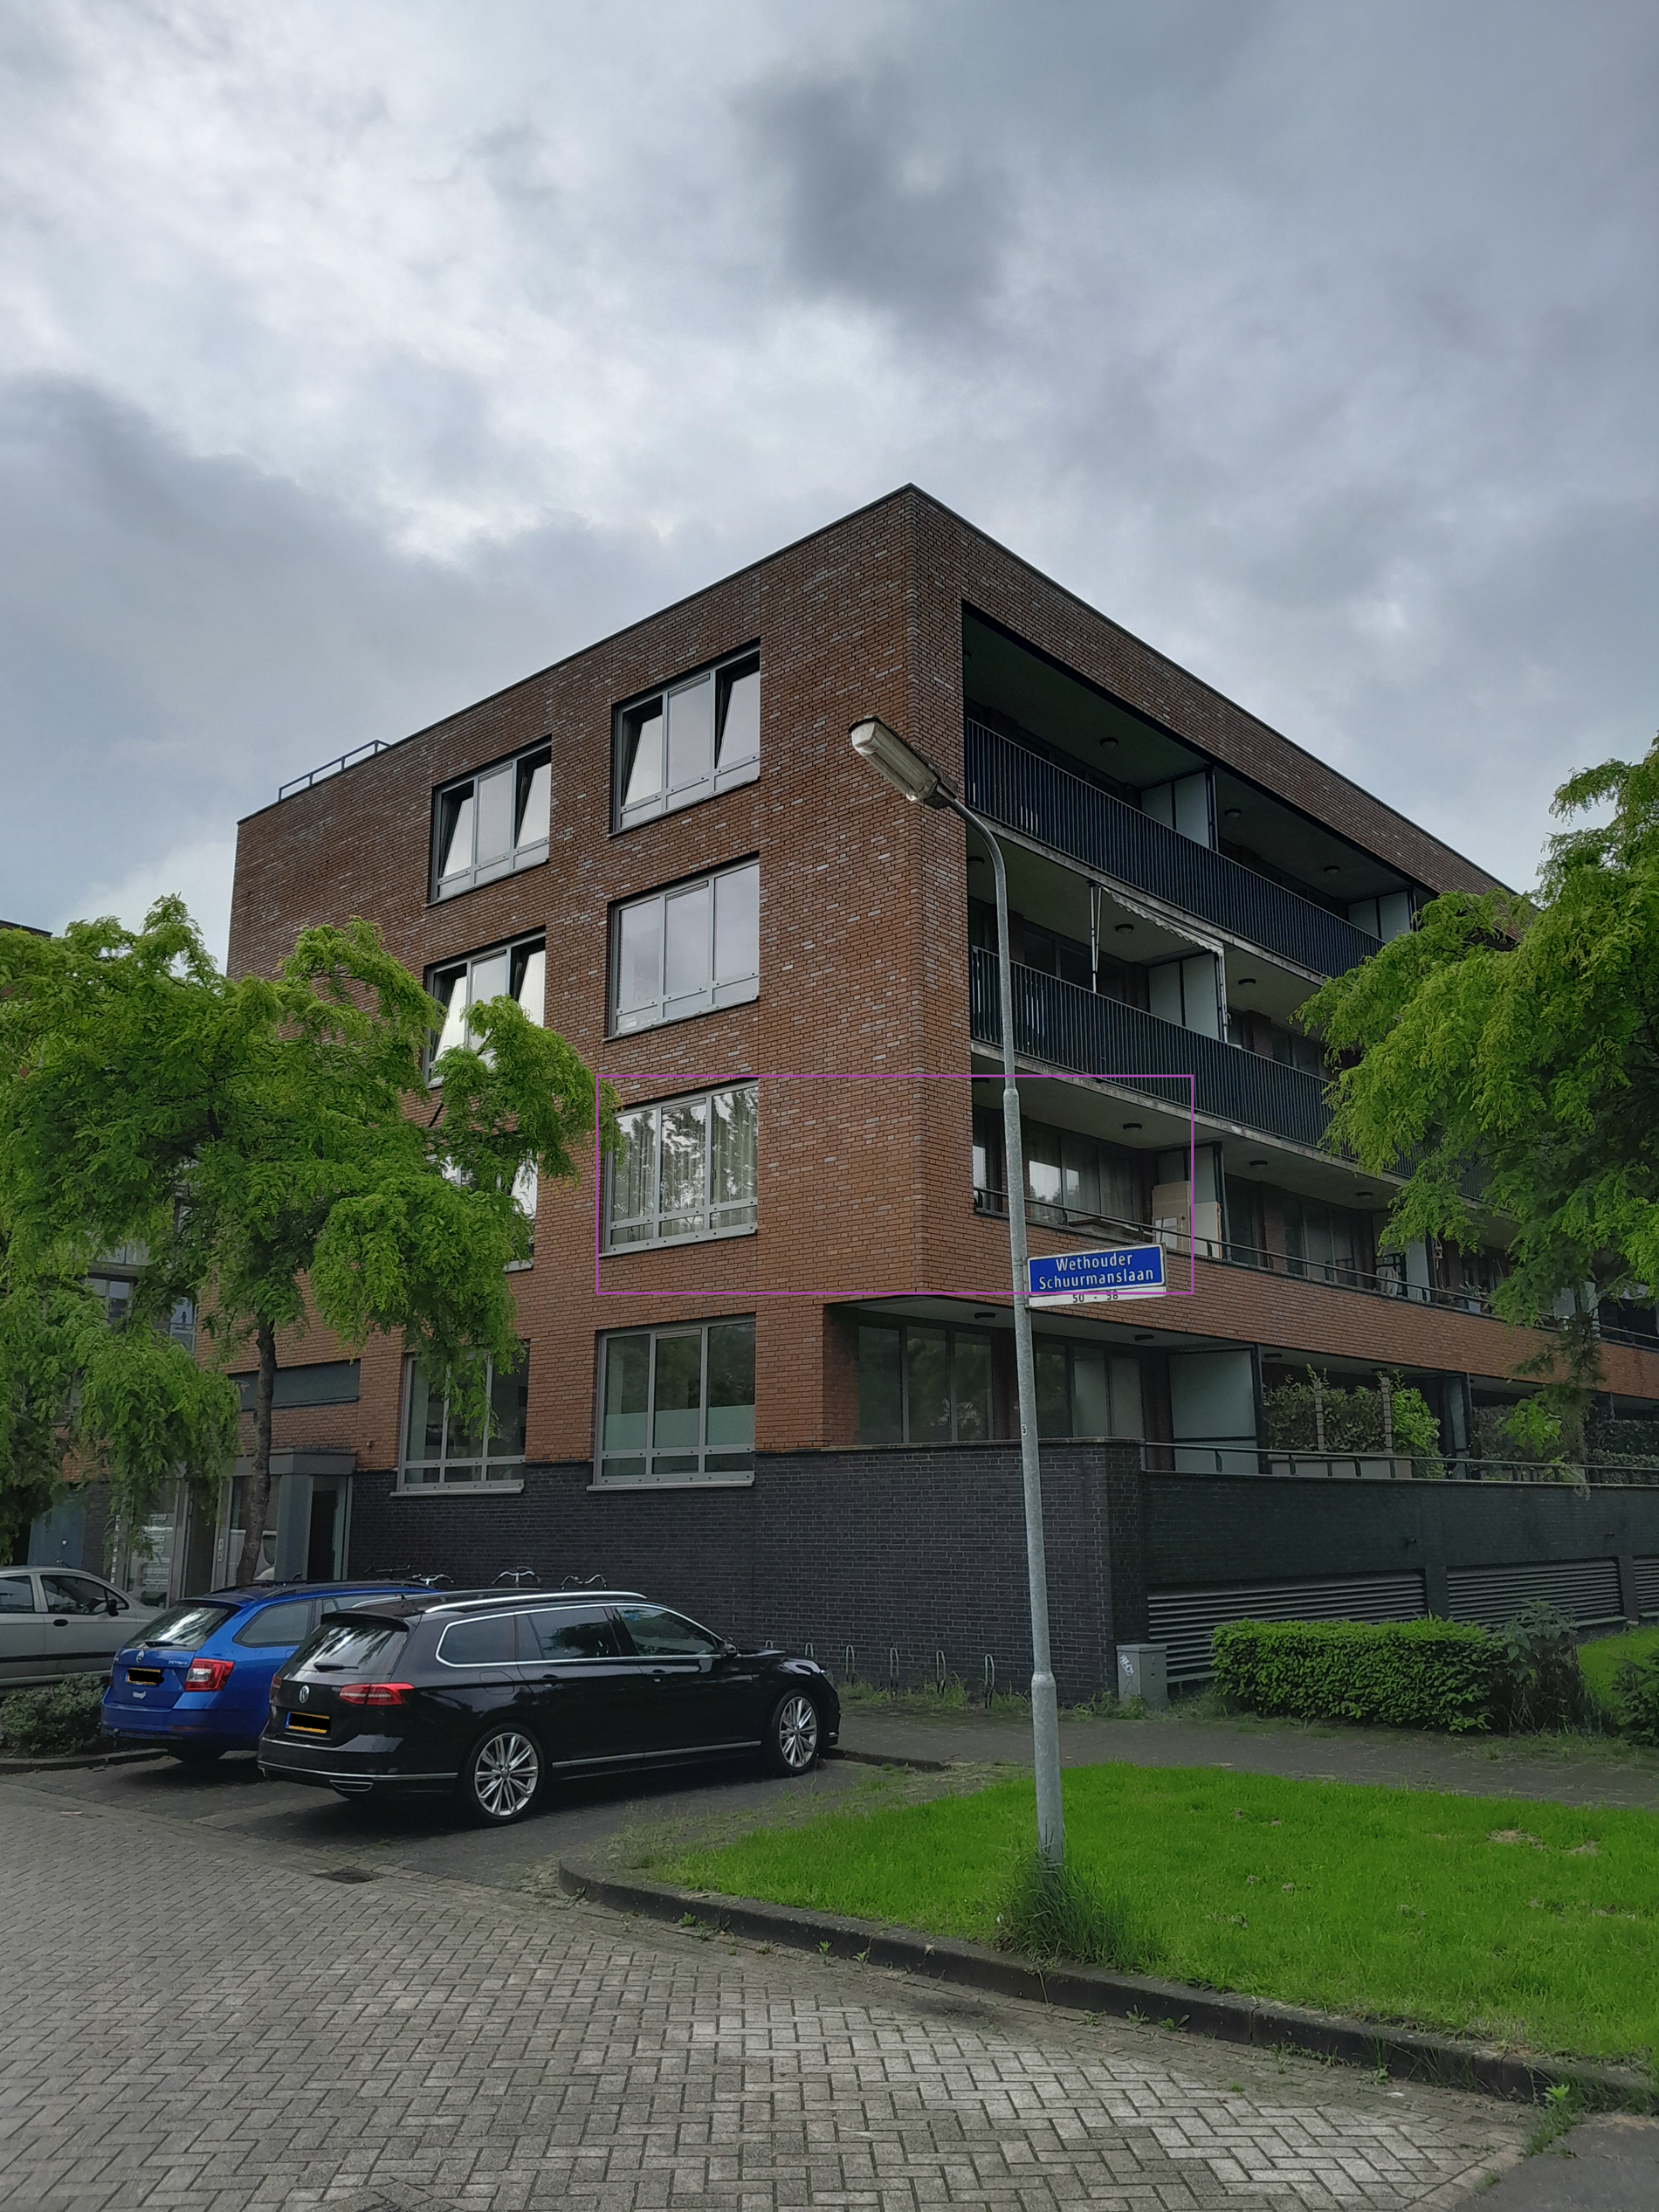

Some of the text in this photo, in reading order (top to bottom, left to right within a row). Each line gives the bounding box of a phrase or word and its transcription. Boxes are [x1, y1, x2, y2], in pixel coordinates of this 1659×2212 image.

[1056, 1253, 1133, 1272] Wethouder
[1039, 1269, 1153, 1290] Schuurmanslaan
[1072, 1293, 1084, 1303] 50
